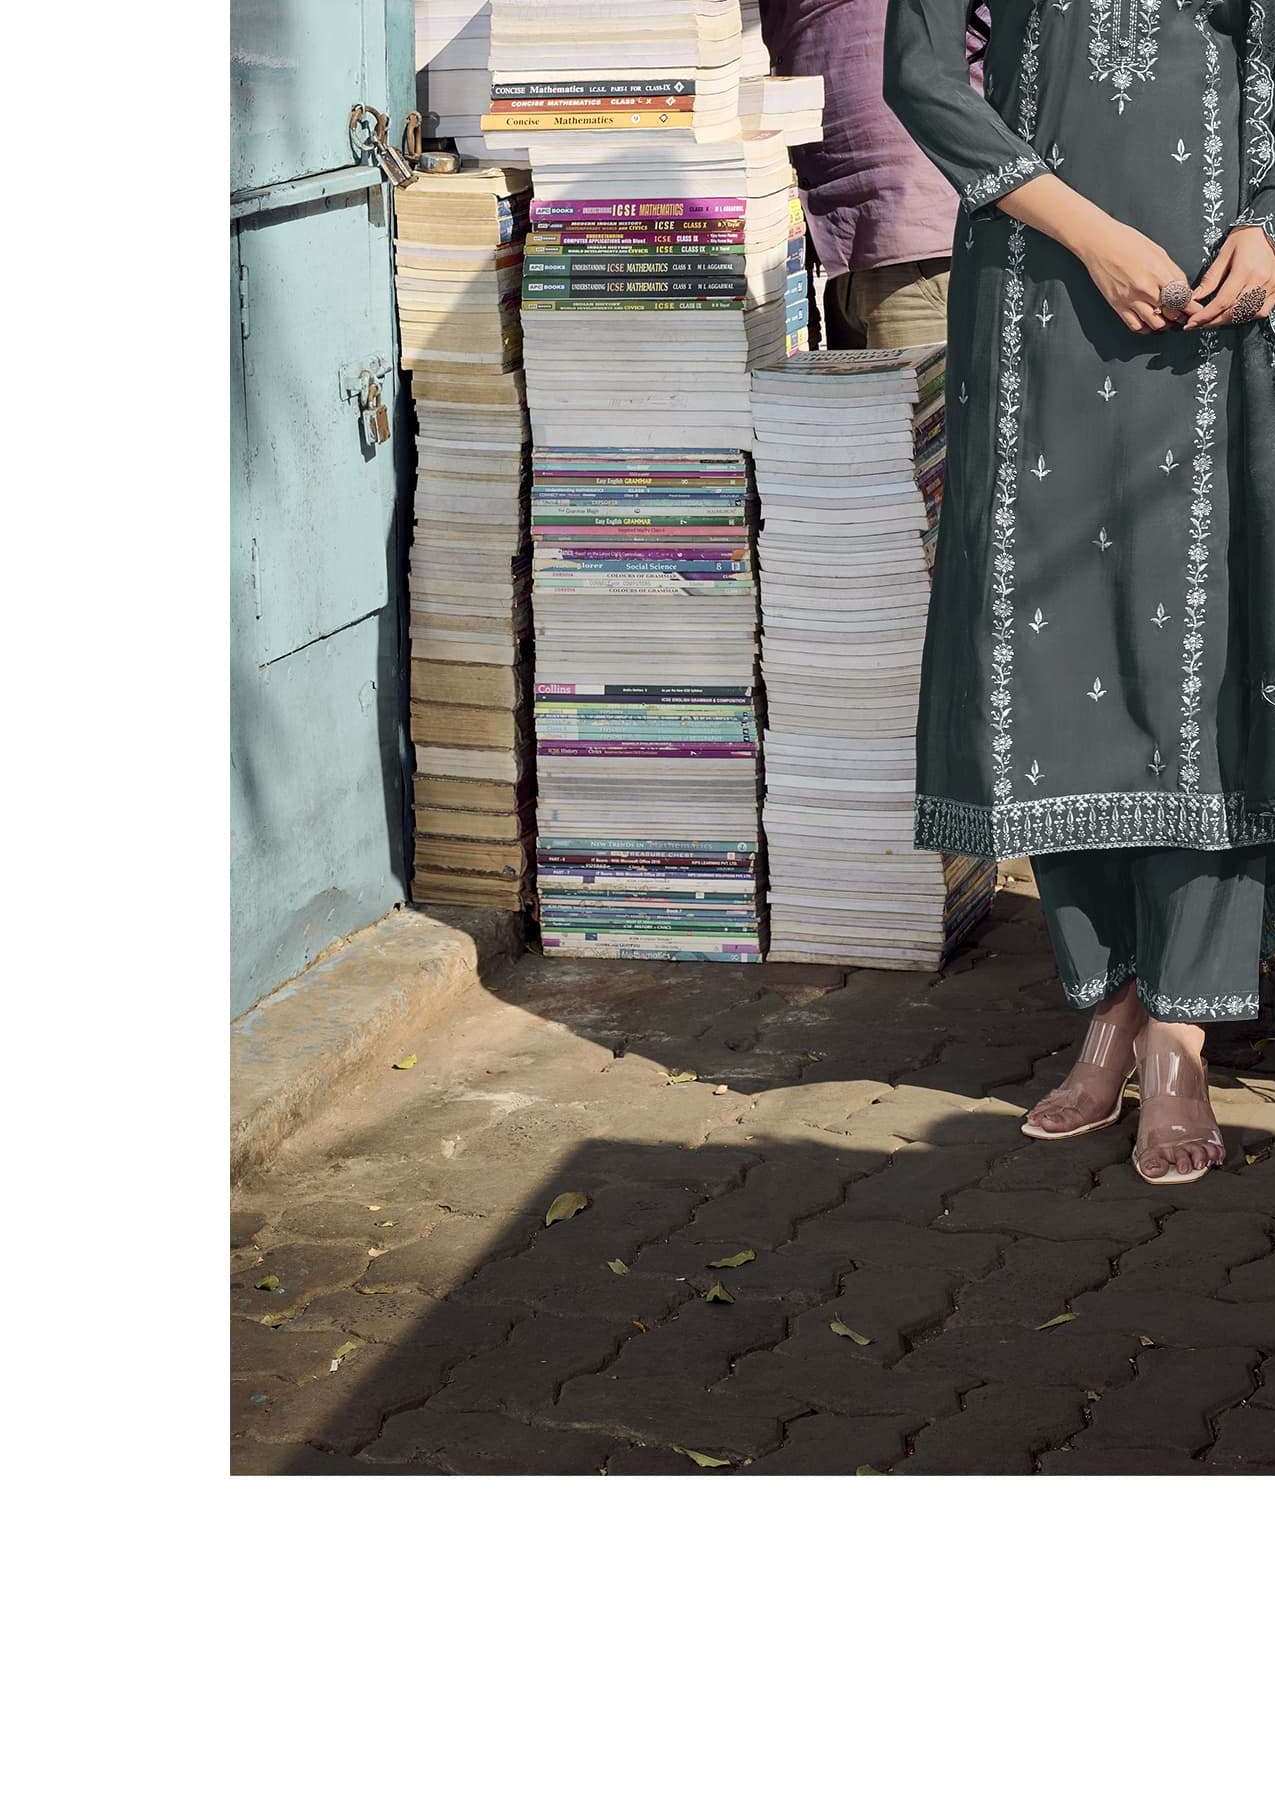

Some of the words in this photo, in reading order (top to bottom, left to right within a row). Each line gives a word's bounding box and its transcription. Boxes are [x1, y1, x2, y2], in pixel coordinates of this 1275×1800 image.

[529, 85, 584, 94] Mathematics
[511, 100, 545, 108] CONCISE
[547, 99, 601, 107] MATHEMATICS
[506, 118, 540, 126] Concise
[553, 116, 614, 125] Mathematics
[612, 204, 637, 217] ICSE
[639, 203, 684, 216] MATHEMATICS
[654, 221, 675, 230] ICSE
[607, 263, 625, 273] ICSE
[626, 263, 668, 273] MATHEMATICS
[607, 282, 624, 292] ICSE
[626, 282, 668, 292] MATHEMATICS
[538, 684, 571, 694] Collins
